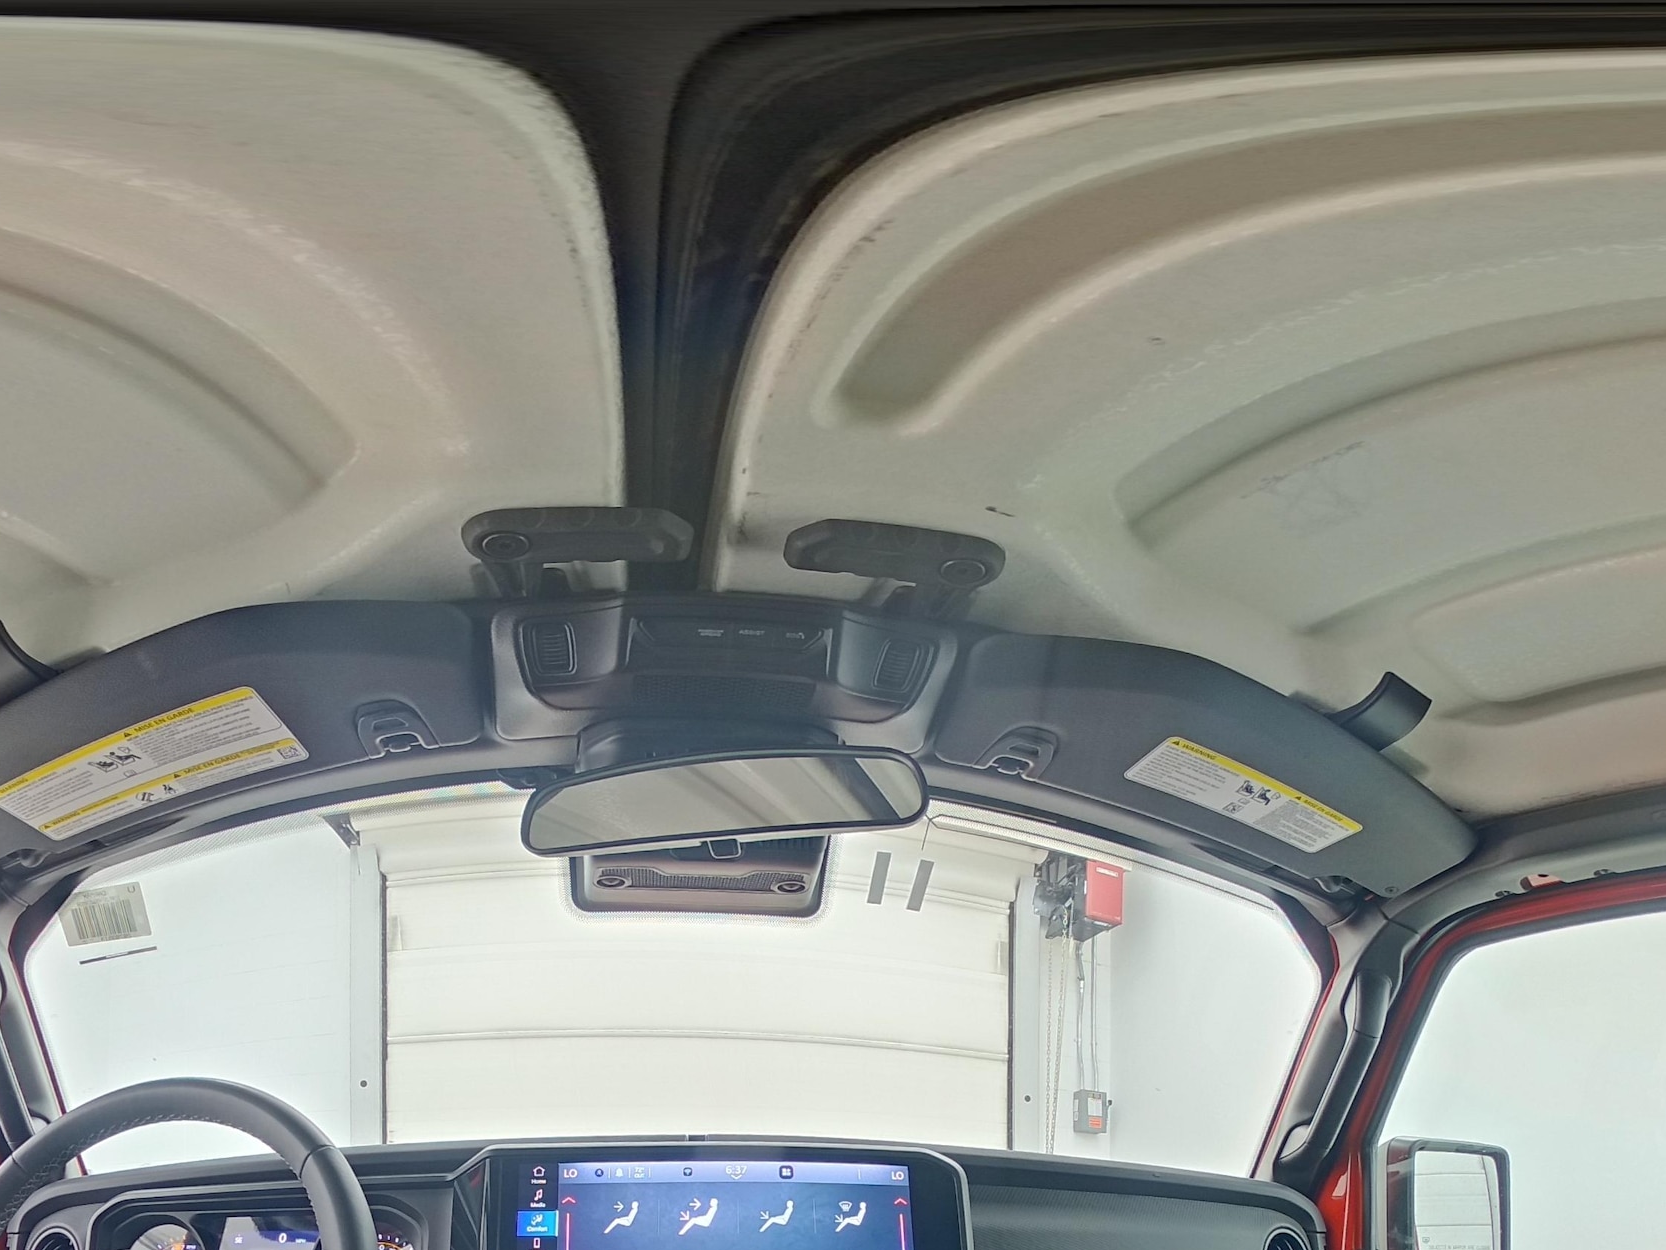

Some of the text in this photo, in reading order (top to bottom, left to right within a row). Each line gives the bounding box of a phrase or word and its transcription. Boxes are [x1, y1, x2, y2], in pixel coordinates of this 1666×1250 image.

[134, 707, 194, 733] MISE EN GARDE
[1182, 743, 1217, 761] WARNING
[184, 752, 240, 775] MISE EN GARDE
[0, 777, 29, 794] WARNING
[564, 1168, 578, 1178] LO
[726, 1166, 747, 1174] 6:37
[891, 1171, 905, 1180] LO
[279, 1233, 287, 1244] 0
